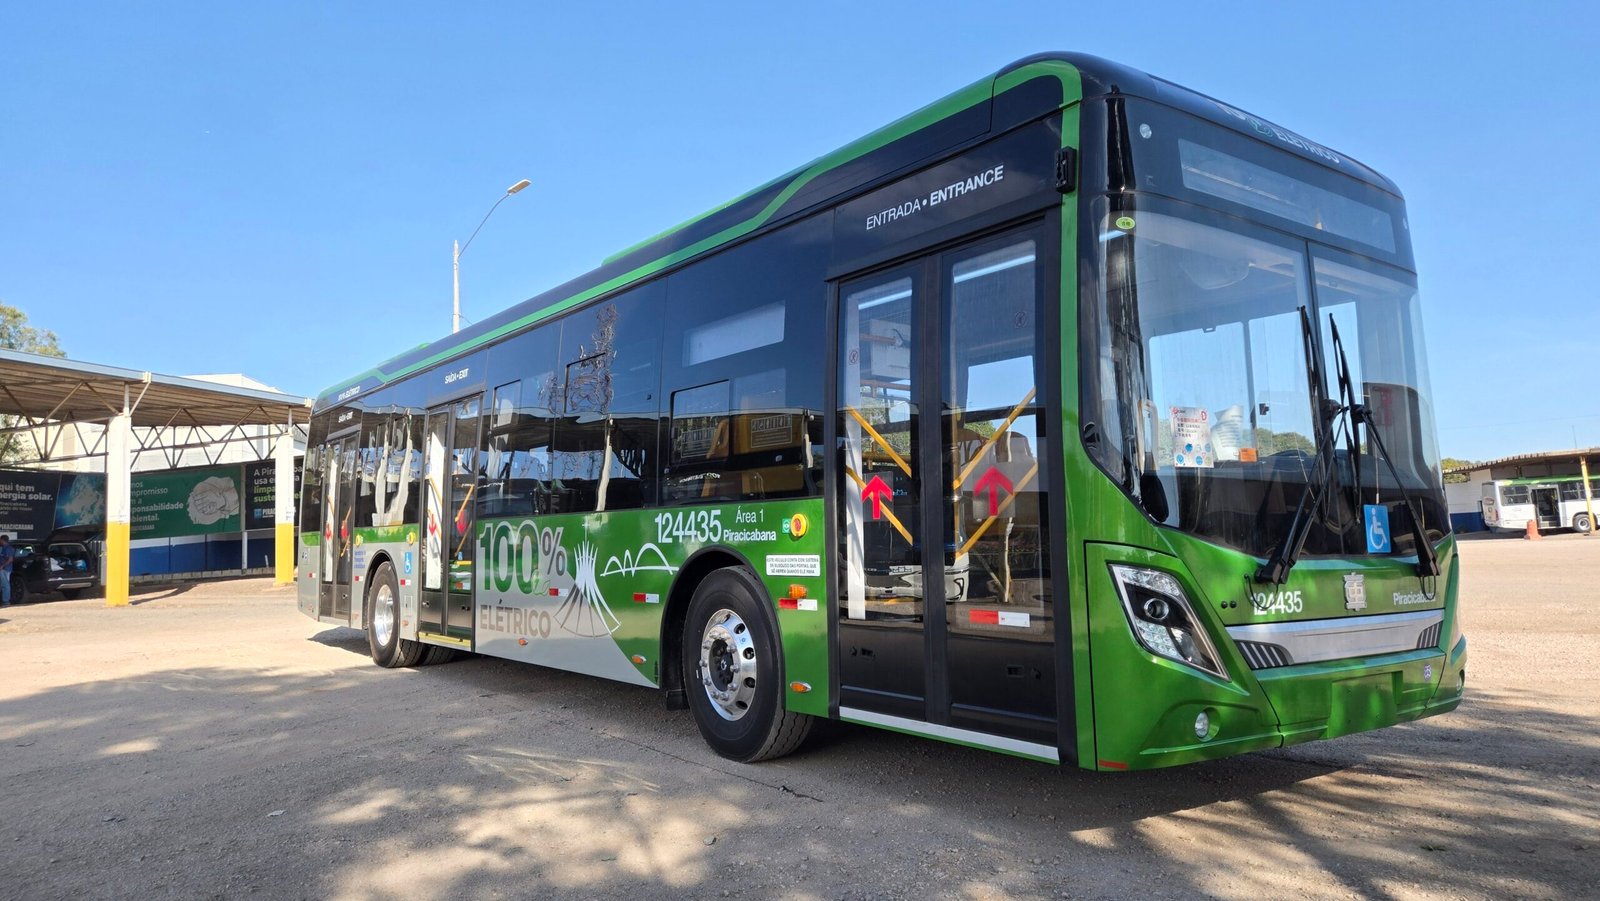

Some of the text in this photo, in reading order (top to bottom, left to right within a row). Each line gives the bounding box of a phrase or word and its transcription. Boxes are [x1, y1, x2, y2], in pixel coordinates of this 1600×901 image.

[866, 165, 1004, 230] ENTRADA ENTRANCE
[458, 368, 469, 380] EXIT
[0, 482, 35, 492] qui tem
[28, 492, 53, 501] solar.
[131, 501, 184, 514] ponsabilidade
[736, 505, 765, 523] Área 1
[131, 513, 160, 522] biental.
[654, 509, 722, 544] 124435
[723, 529, 777, 542] Piracicabana
[479, 519, 568, 594] 100%
[1250, 590, 1304, 616] 124435
[480, 598, 551, 638] ELÉTRICO
